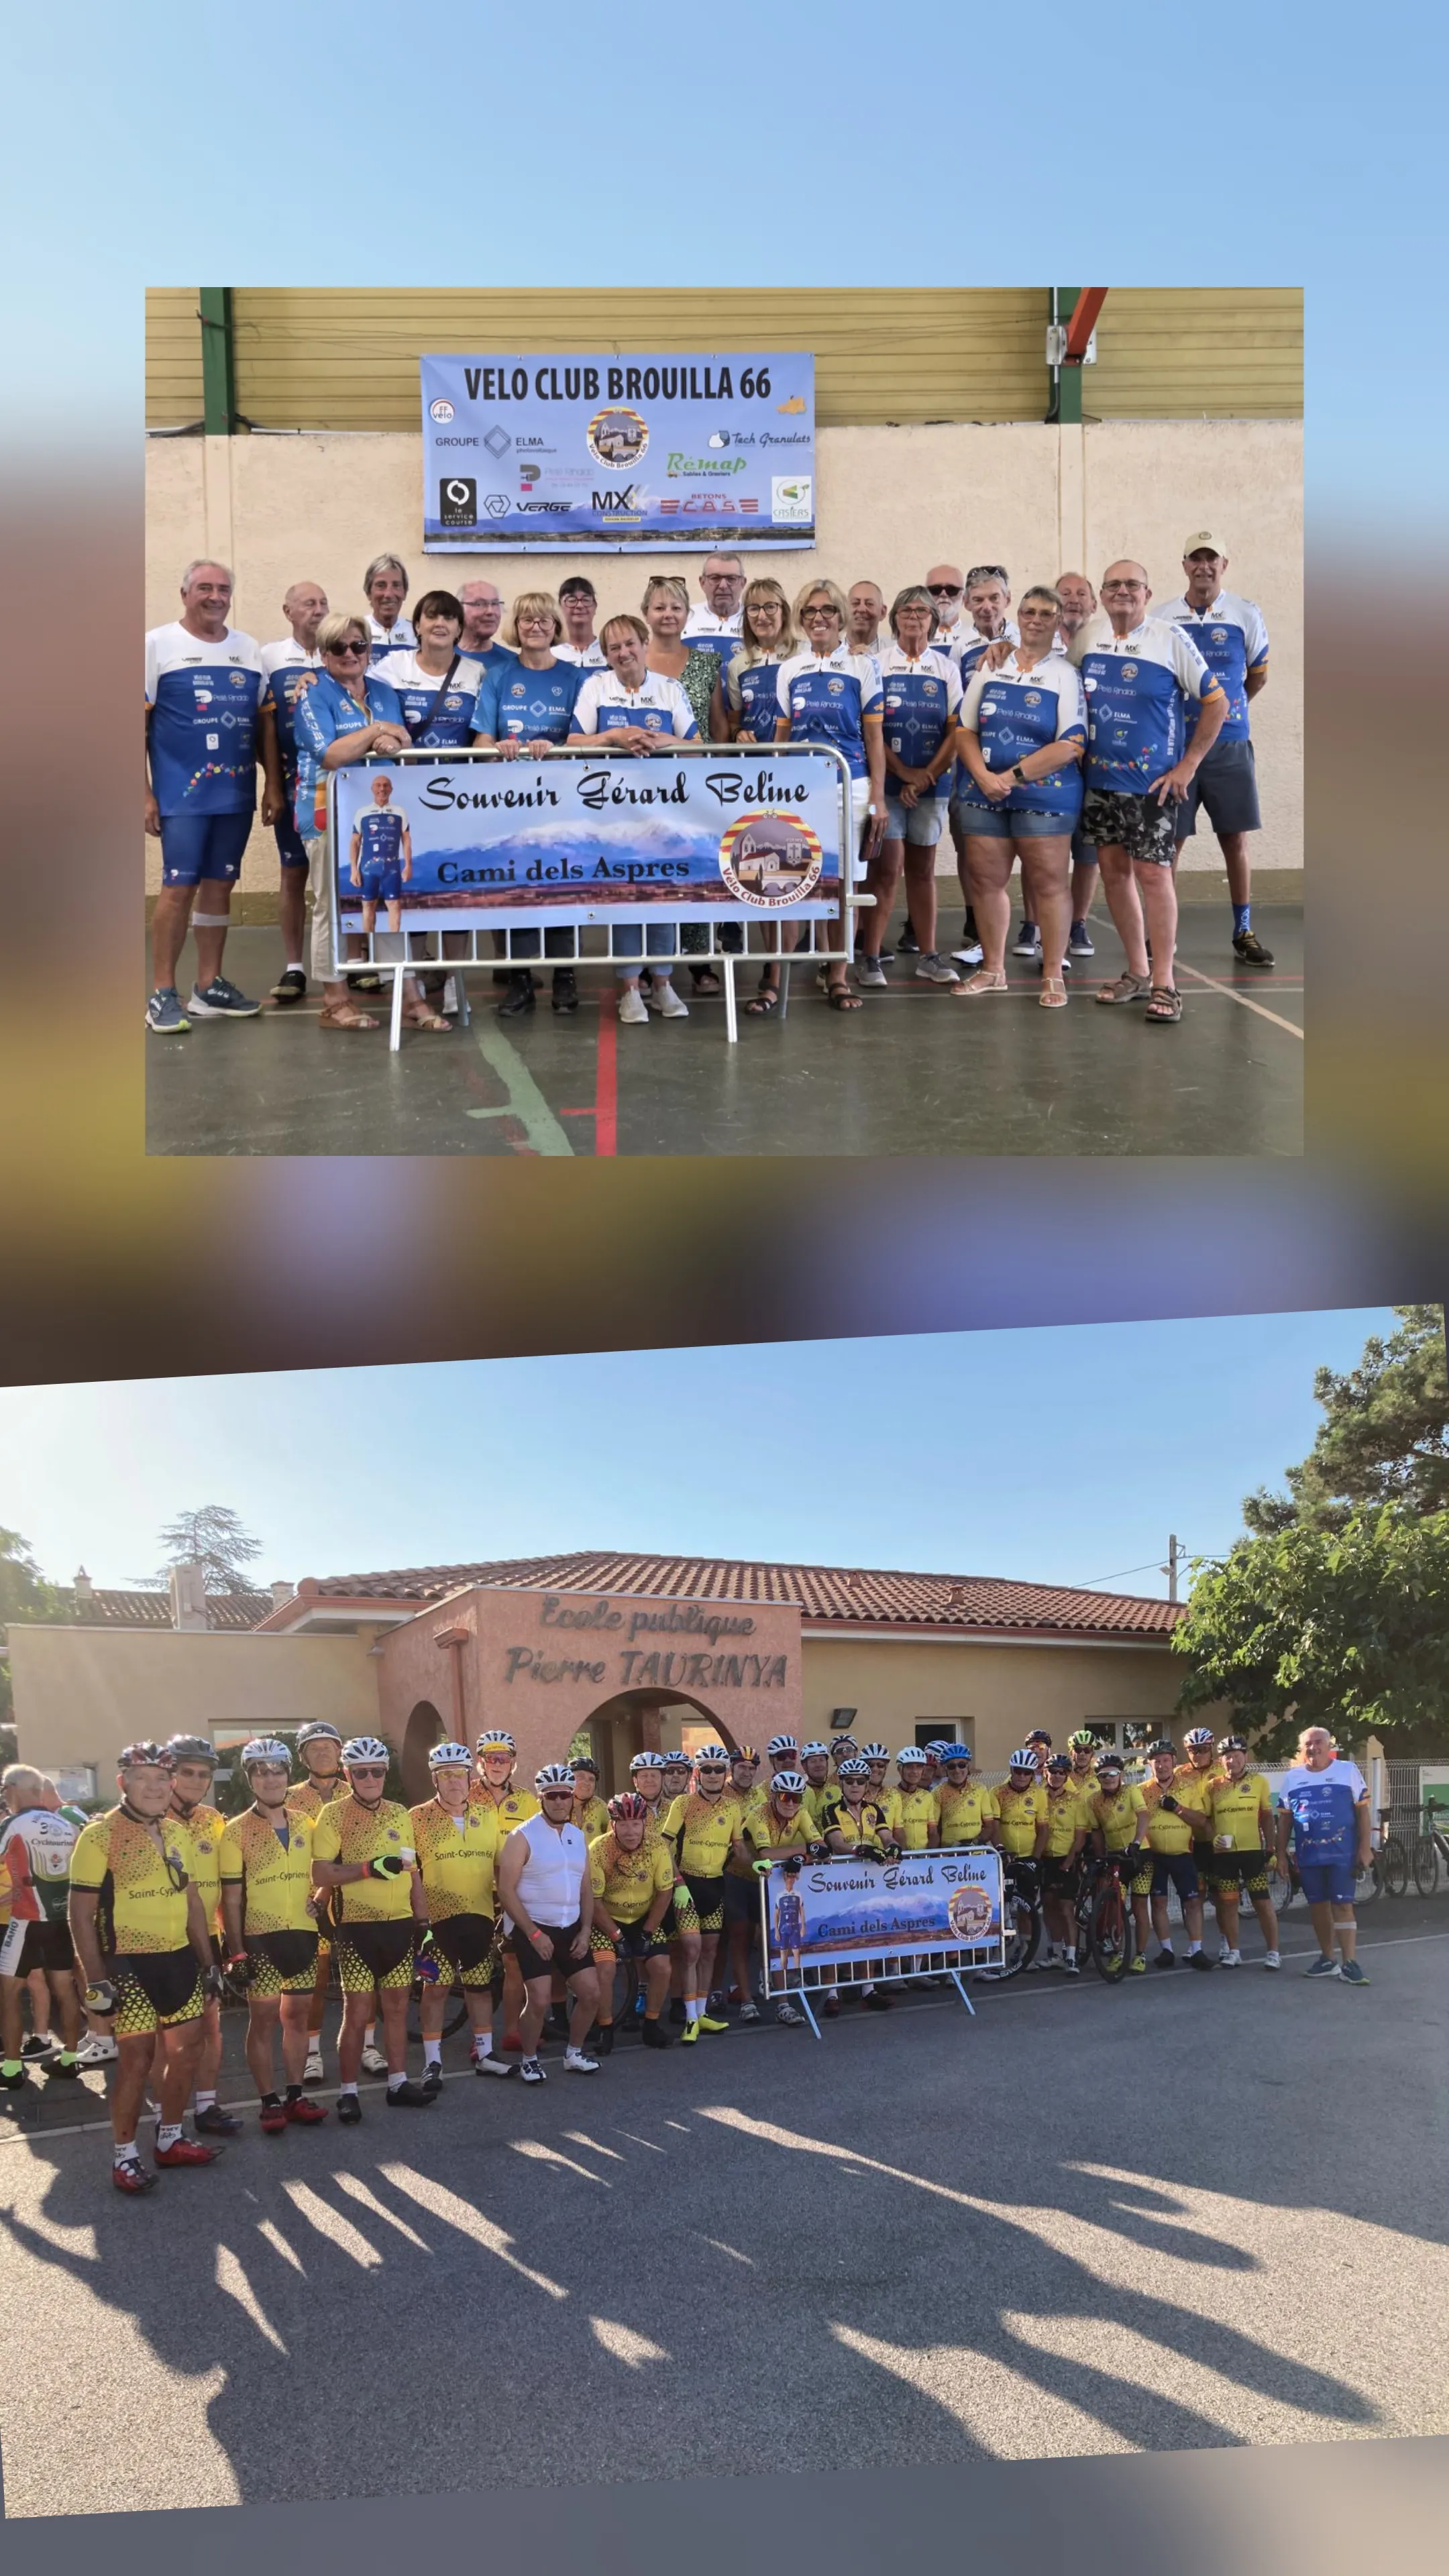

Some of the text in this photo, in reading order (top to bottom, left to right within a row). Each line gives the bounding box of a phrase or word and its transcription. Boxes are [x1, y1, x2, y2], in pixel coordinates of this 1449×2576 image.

[464, 367, 771, 400] VELO CLUB BROUILLA 66
[435, 437, 544, 447] GROUPE ELMA
[732, 432, 811, 448] Tech Granulats
[667, 452, 747, 474] Rémap
[1016, 735, 1034, 743] ELMA
[418, 771, 810, 811] Souvenir Gérard Beline
[437, 855, 690, 885] Cami dels Aspres
[741, 890, 765, 906] Club
[768, 882, 812, 907] Brouilla
[808, 865, 820, 882] 66
[625, 1603, 757, 1646] publique
[504, 1646, 788, 1688] Pierre TAURINYA
[435, 1849, 485, 1861] Saint-Cyprien
[255, 1871, 305, 1886] Saint-Cyprien
[807, 1864, 987, 1893] Souvenir Gérard Beline
[129, 1886, 176, 1900] Saint-Cyp
[817, 1915, 936, 1938] Cami dels Aspres
